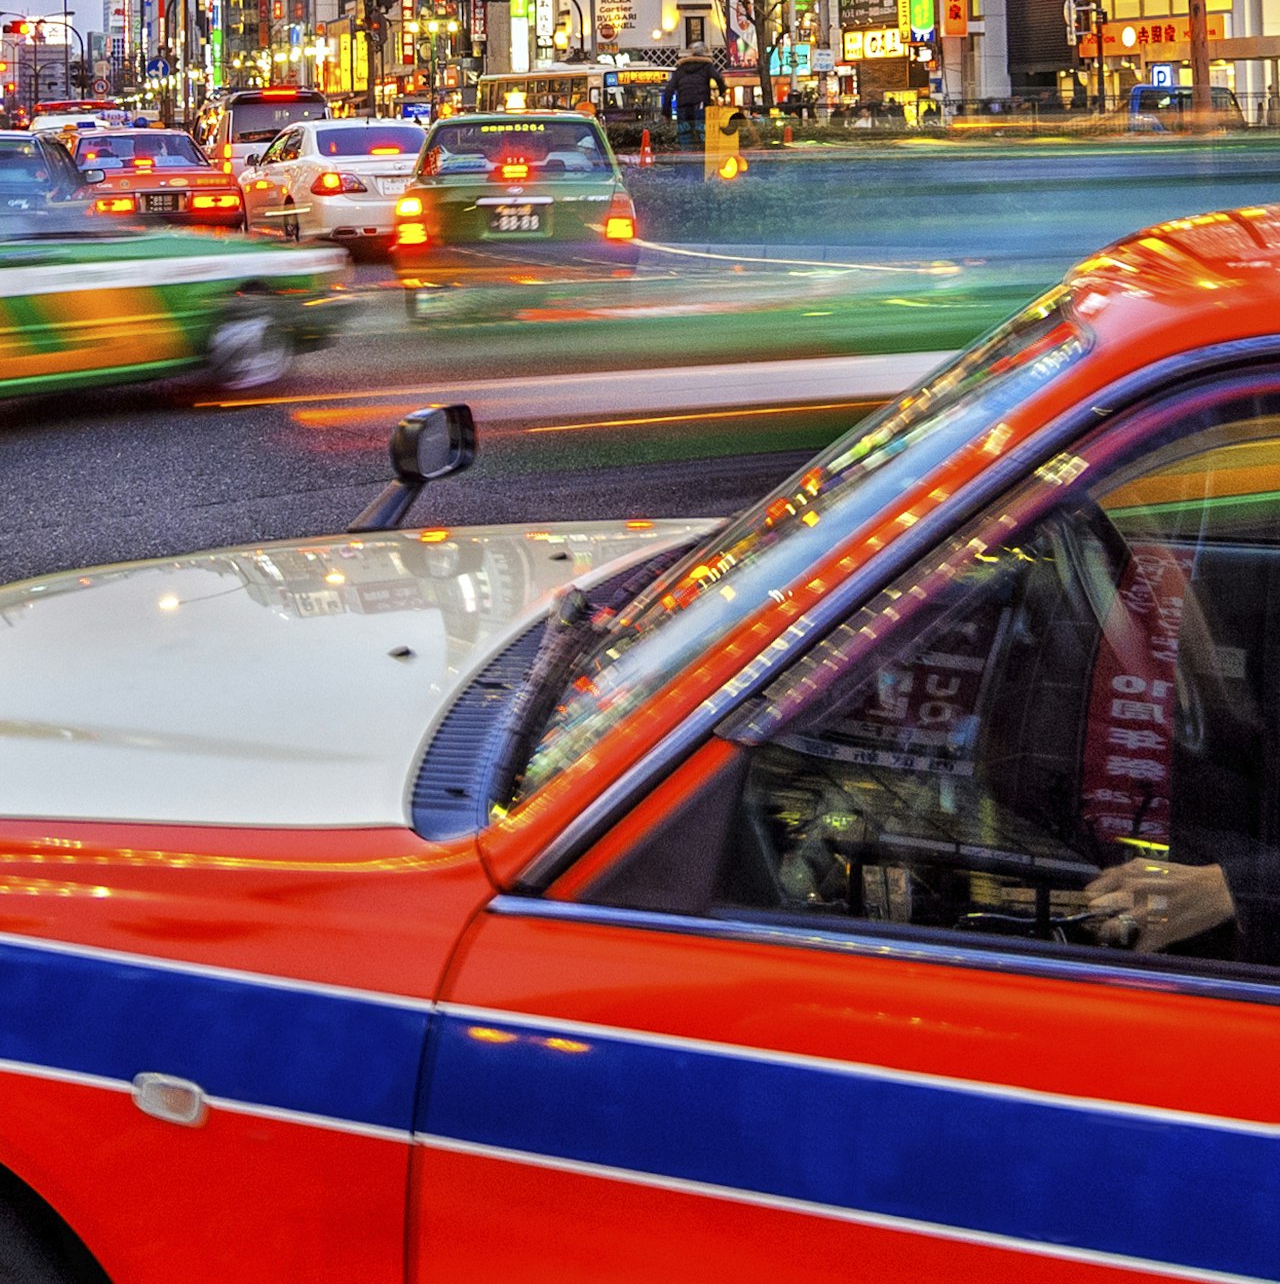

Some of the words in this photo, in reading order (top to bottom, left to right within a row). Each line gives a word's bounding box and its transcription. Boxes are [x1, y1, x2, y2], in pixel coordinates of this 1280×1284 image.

[599, 5, 634, 14] Cartier
[1138, 24, 1177, 45] 吉野家
[1156, 71, 1167, 87] P
